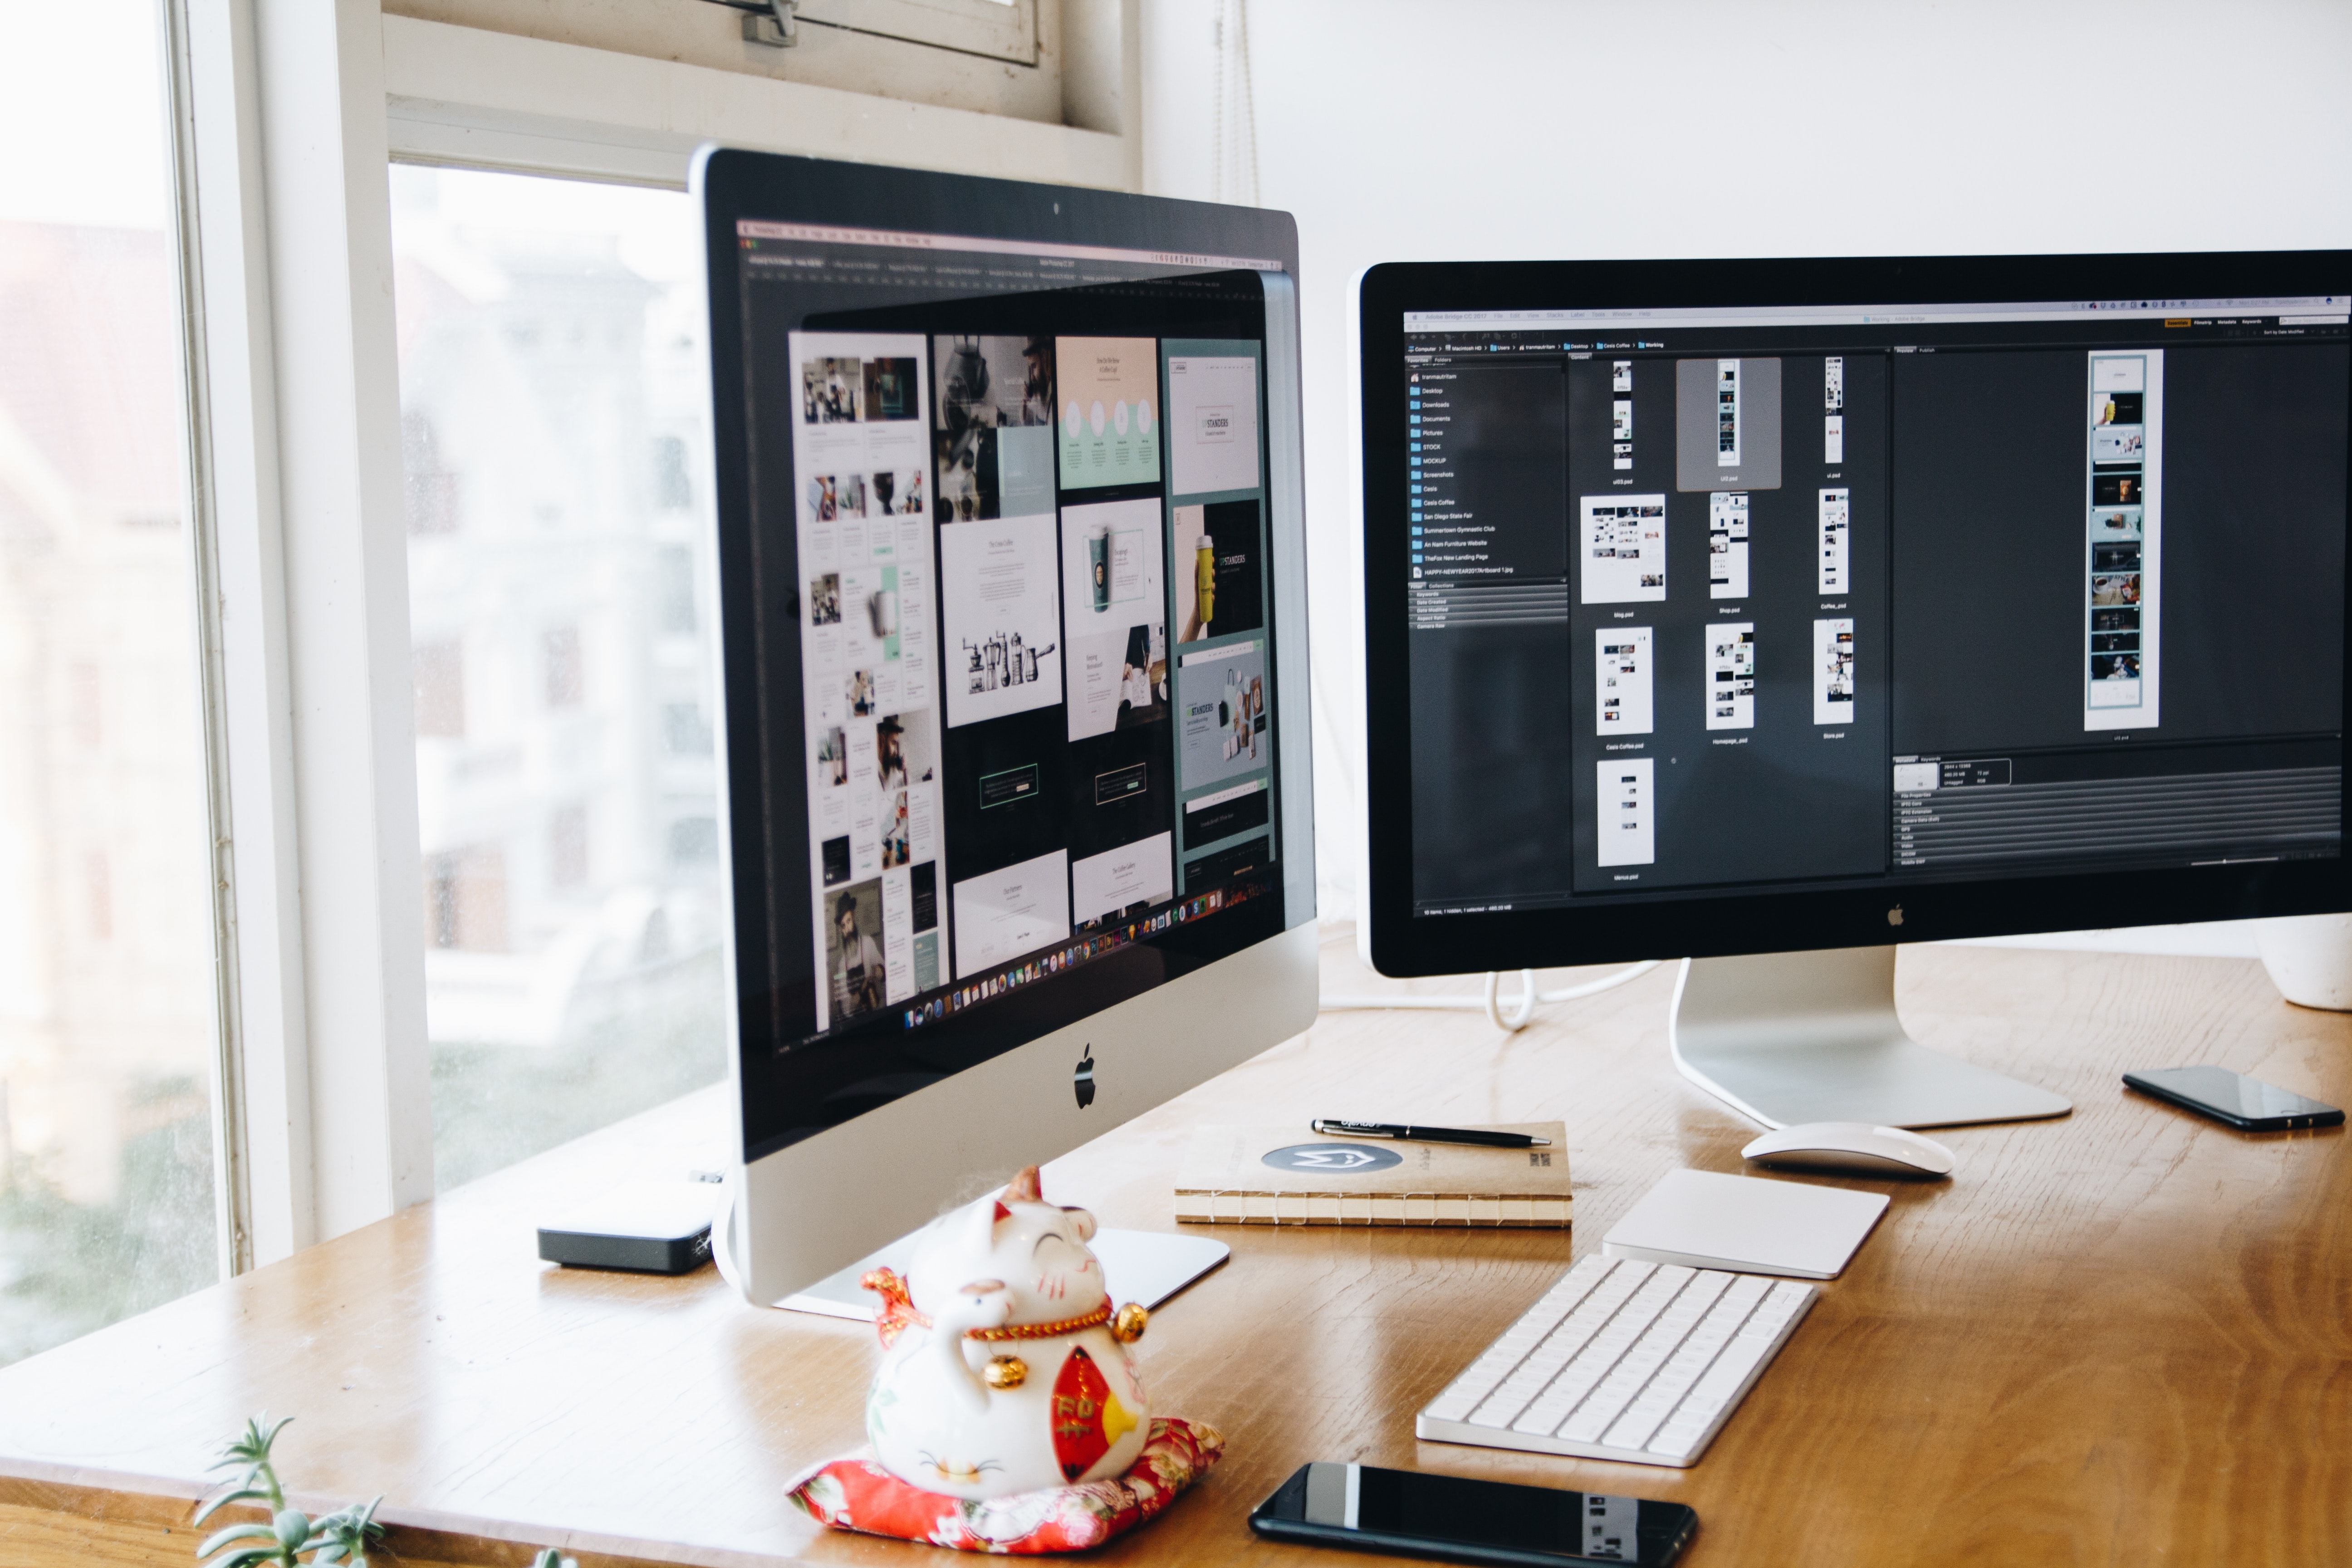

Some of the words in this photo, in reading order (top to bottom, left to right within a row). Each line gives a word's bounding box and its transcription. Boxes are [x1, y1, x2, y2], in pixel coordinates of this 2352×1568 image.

[1422, 387, 1443, 395] Desktop
[1202, 418, 1229, 428] UPSTANDERS
[1423, 470, 1454, 479] Screenshots
[1457, 526, 1483, 534] Gymnastic
[1219, 554, 1246, 567] UPSTANDERS
[1613, 610, 1634, 618] blog.psd
[1619, 742, 1644, 750] Coffee.psd
